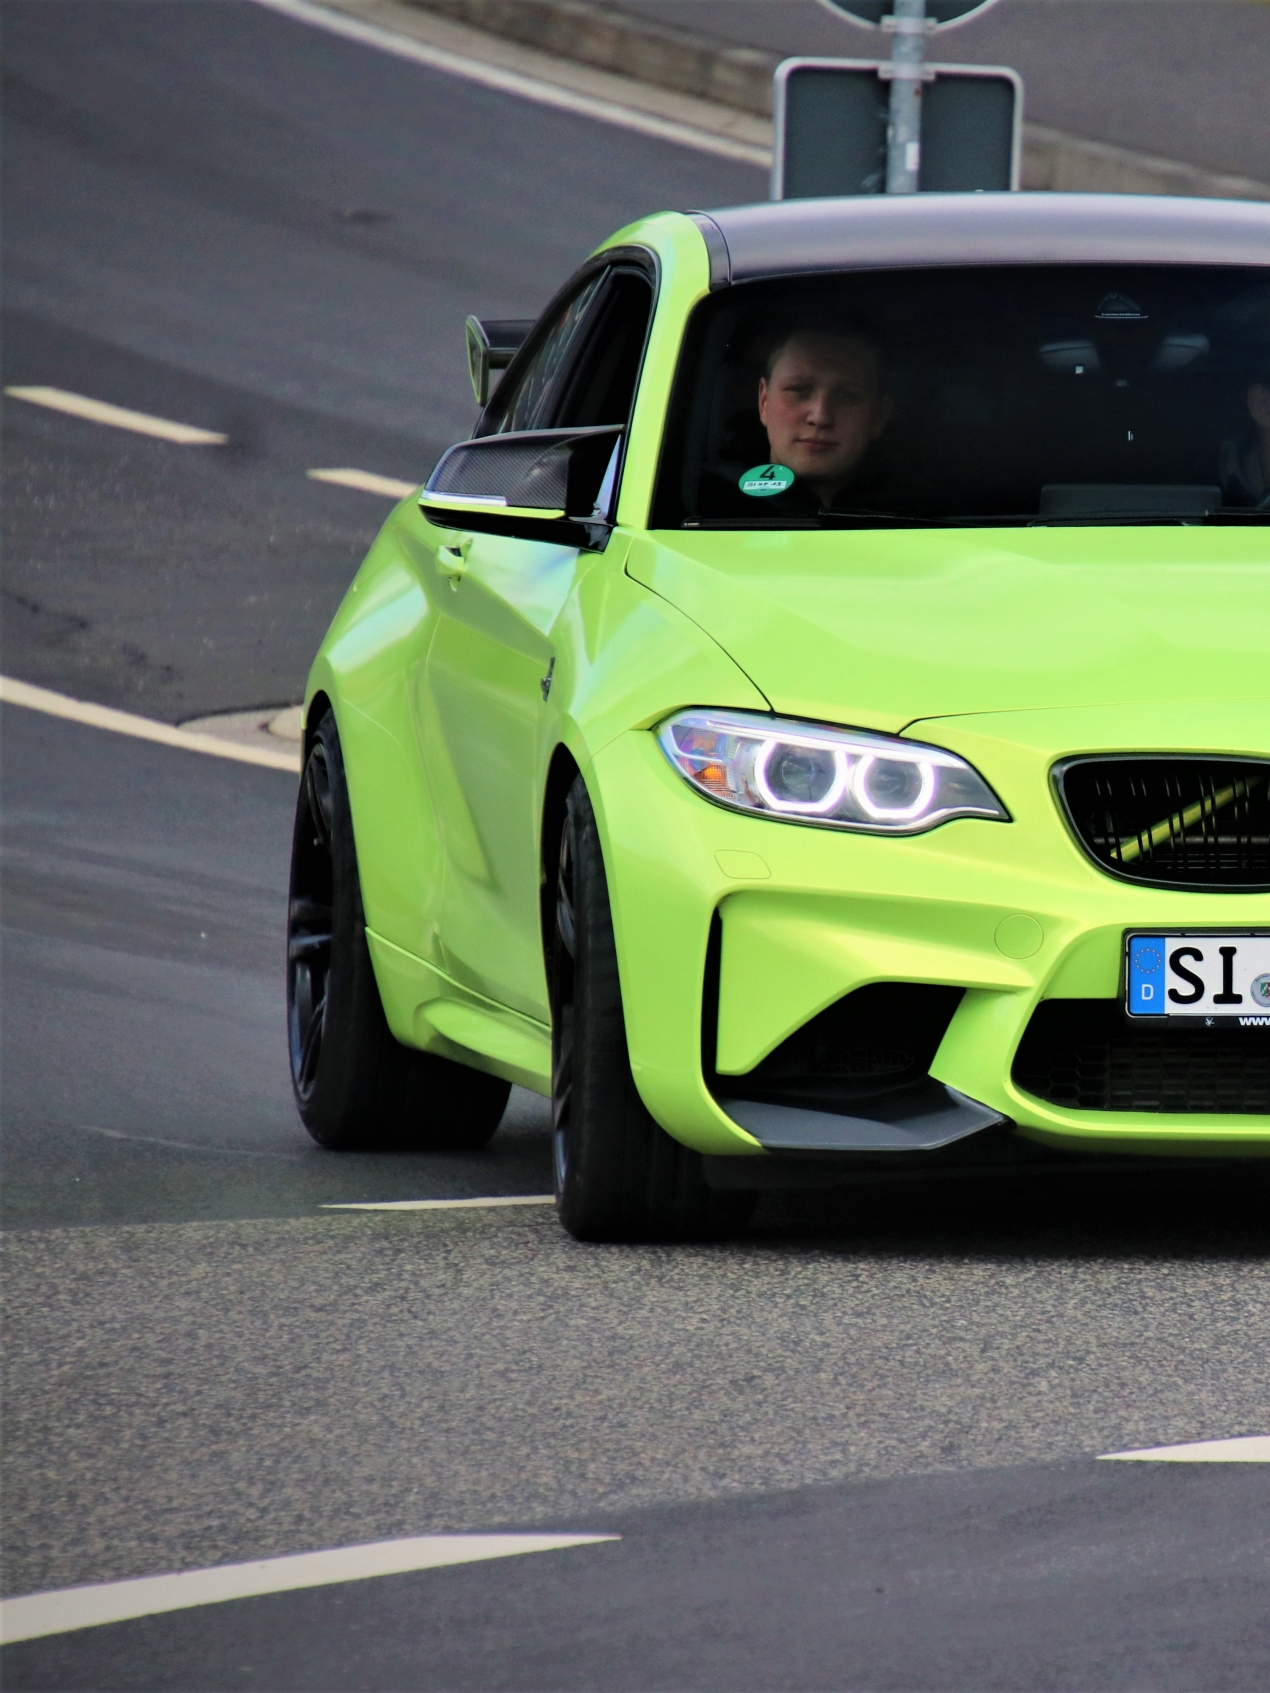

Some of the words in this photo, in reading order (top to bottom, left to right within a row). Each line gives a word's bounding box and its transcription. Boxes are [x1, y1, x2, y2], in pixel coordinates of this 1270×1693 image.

[759, 465, 776, 480] 4
[1167, 945, 1243, 1004] SI
[1141, 983, 1154, 1001] D
